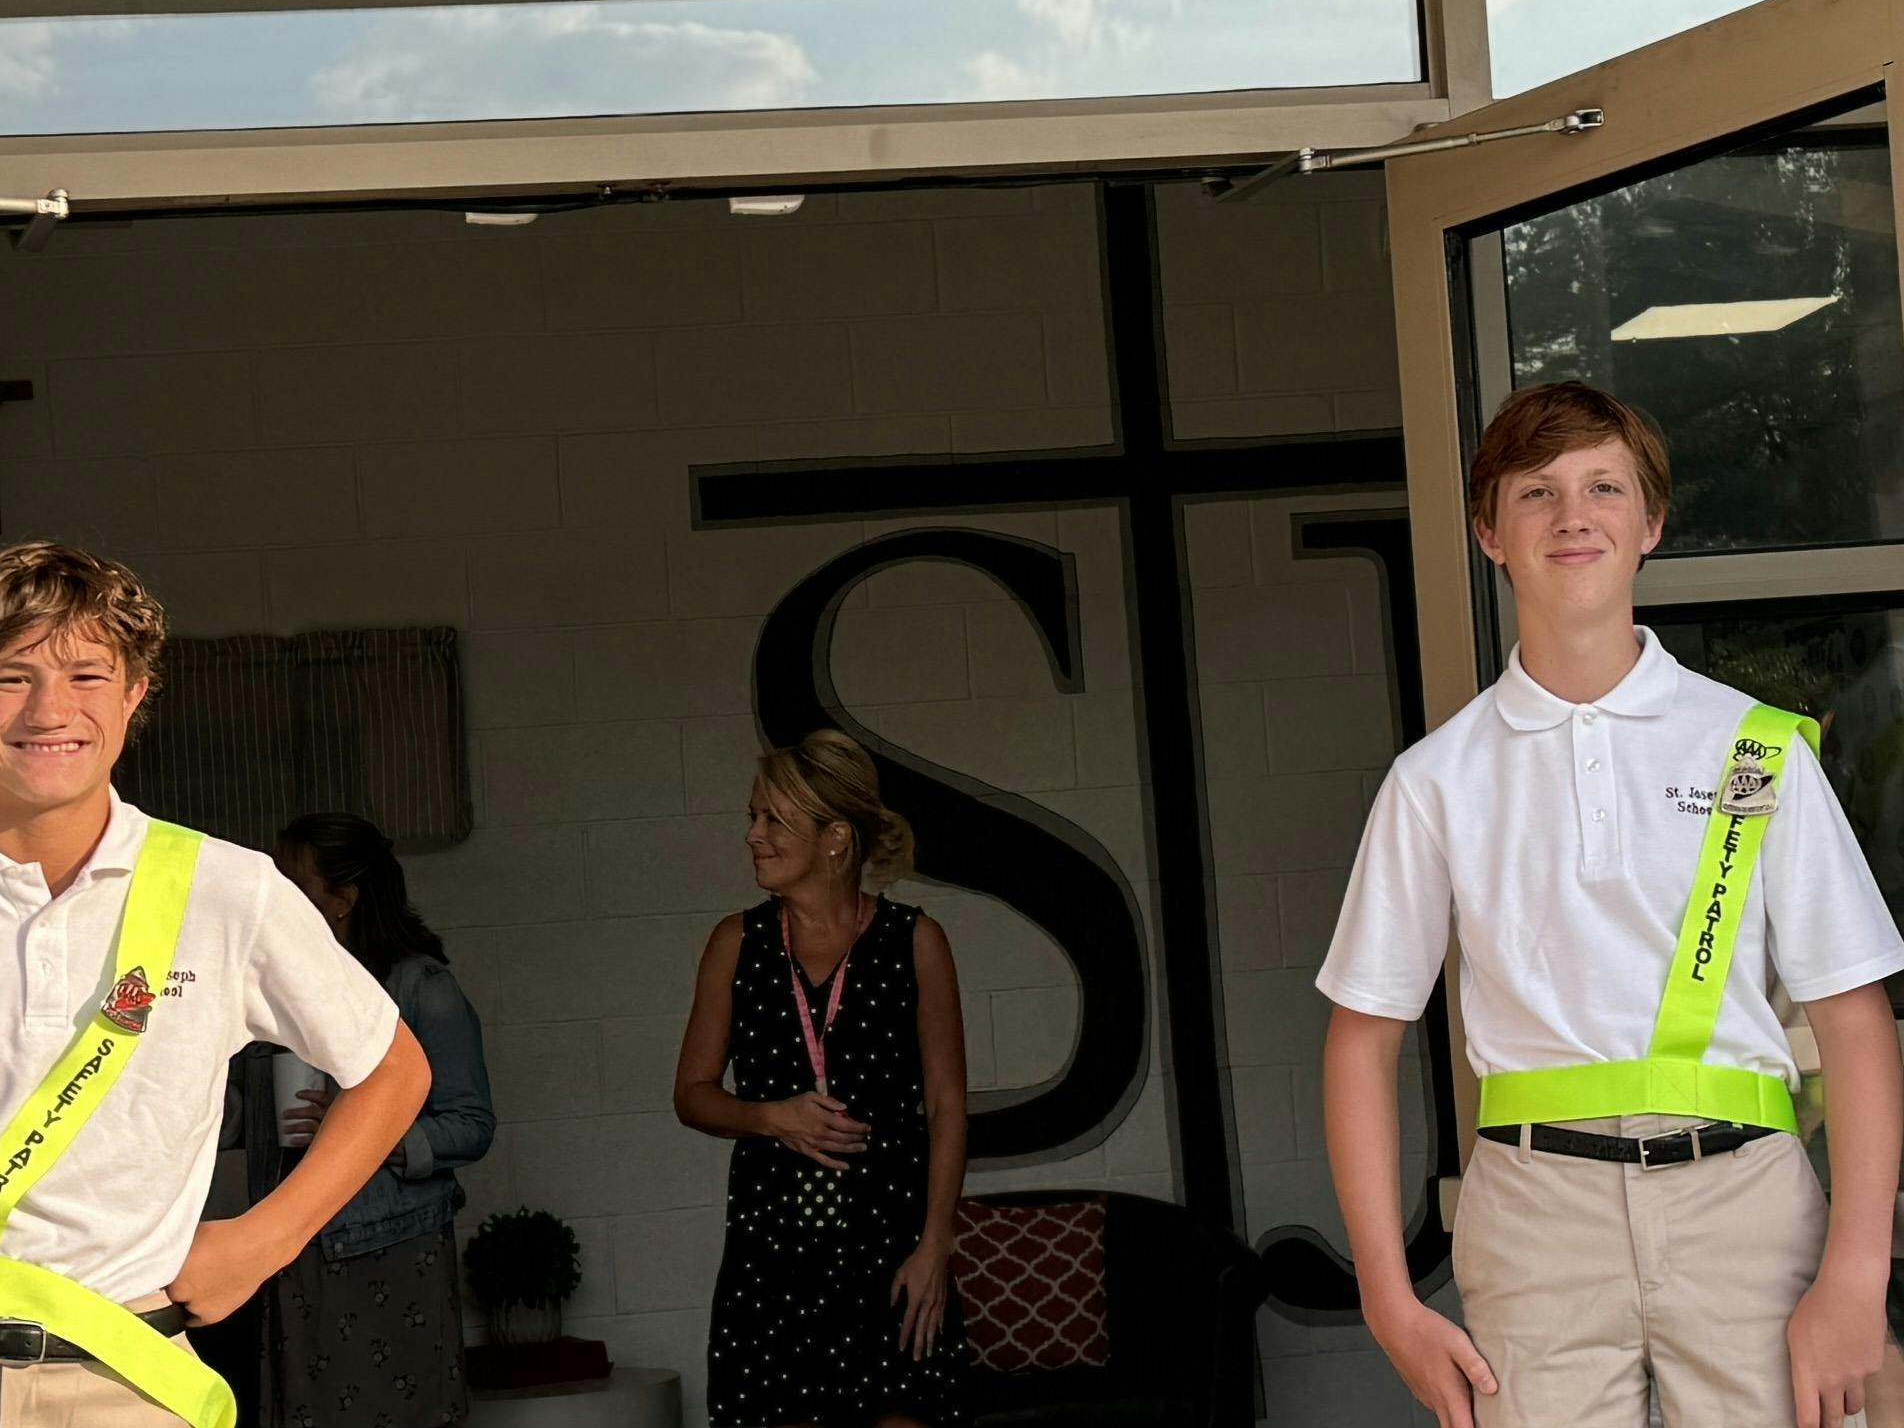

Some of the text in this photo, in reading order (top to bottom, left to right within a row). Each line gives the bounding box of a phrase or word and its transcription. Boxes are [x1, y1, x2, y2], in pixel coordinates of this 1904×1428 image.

[1665, 786, 1684, 799] St.
[1692, 815, 1746, 982] FETY PATROL
[43, 1038, 115, 1129] SAFETY
